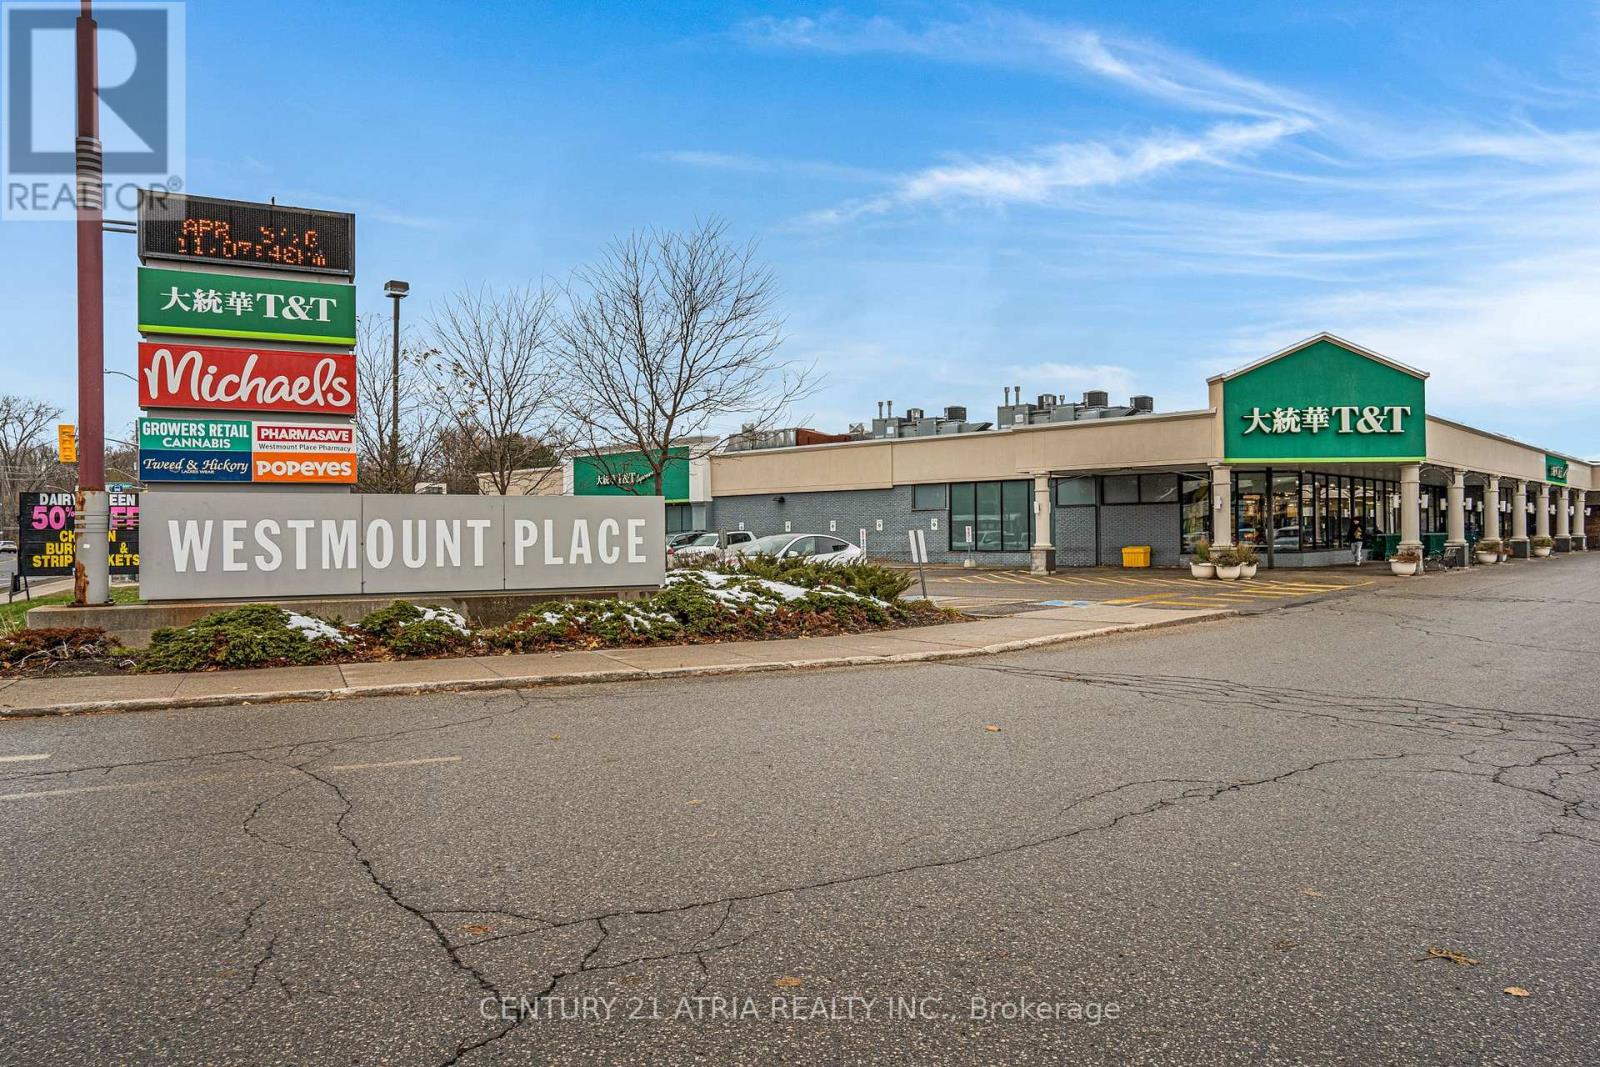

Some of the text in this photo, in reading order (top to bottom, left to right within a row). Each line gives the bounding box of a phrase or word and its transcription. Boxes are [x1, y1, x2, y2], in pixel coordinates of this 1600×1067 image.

[160, 286, 337, 322] 大統華 T&T
[144, 348, 351, 407] Michaels
[1242, 405, 1411, 435] 大統華 T&T
[142, 421, 249, 438] GROWERS RETAIL
[260, 427, 349, 442] PHARMASAVE
[162, 437, 231, 449] CANNABIS
[258, 443, 352, 453] Westmount Place Pharmacy
[143, 457, 249, 474] Tweed & Hickory
[119, 542, 129, 554] &
[168, 518, 647, 573] WESTMOUNT PLACE
[32, 554, 73, 568] STRIP
